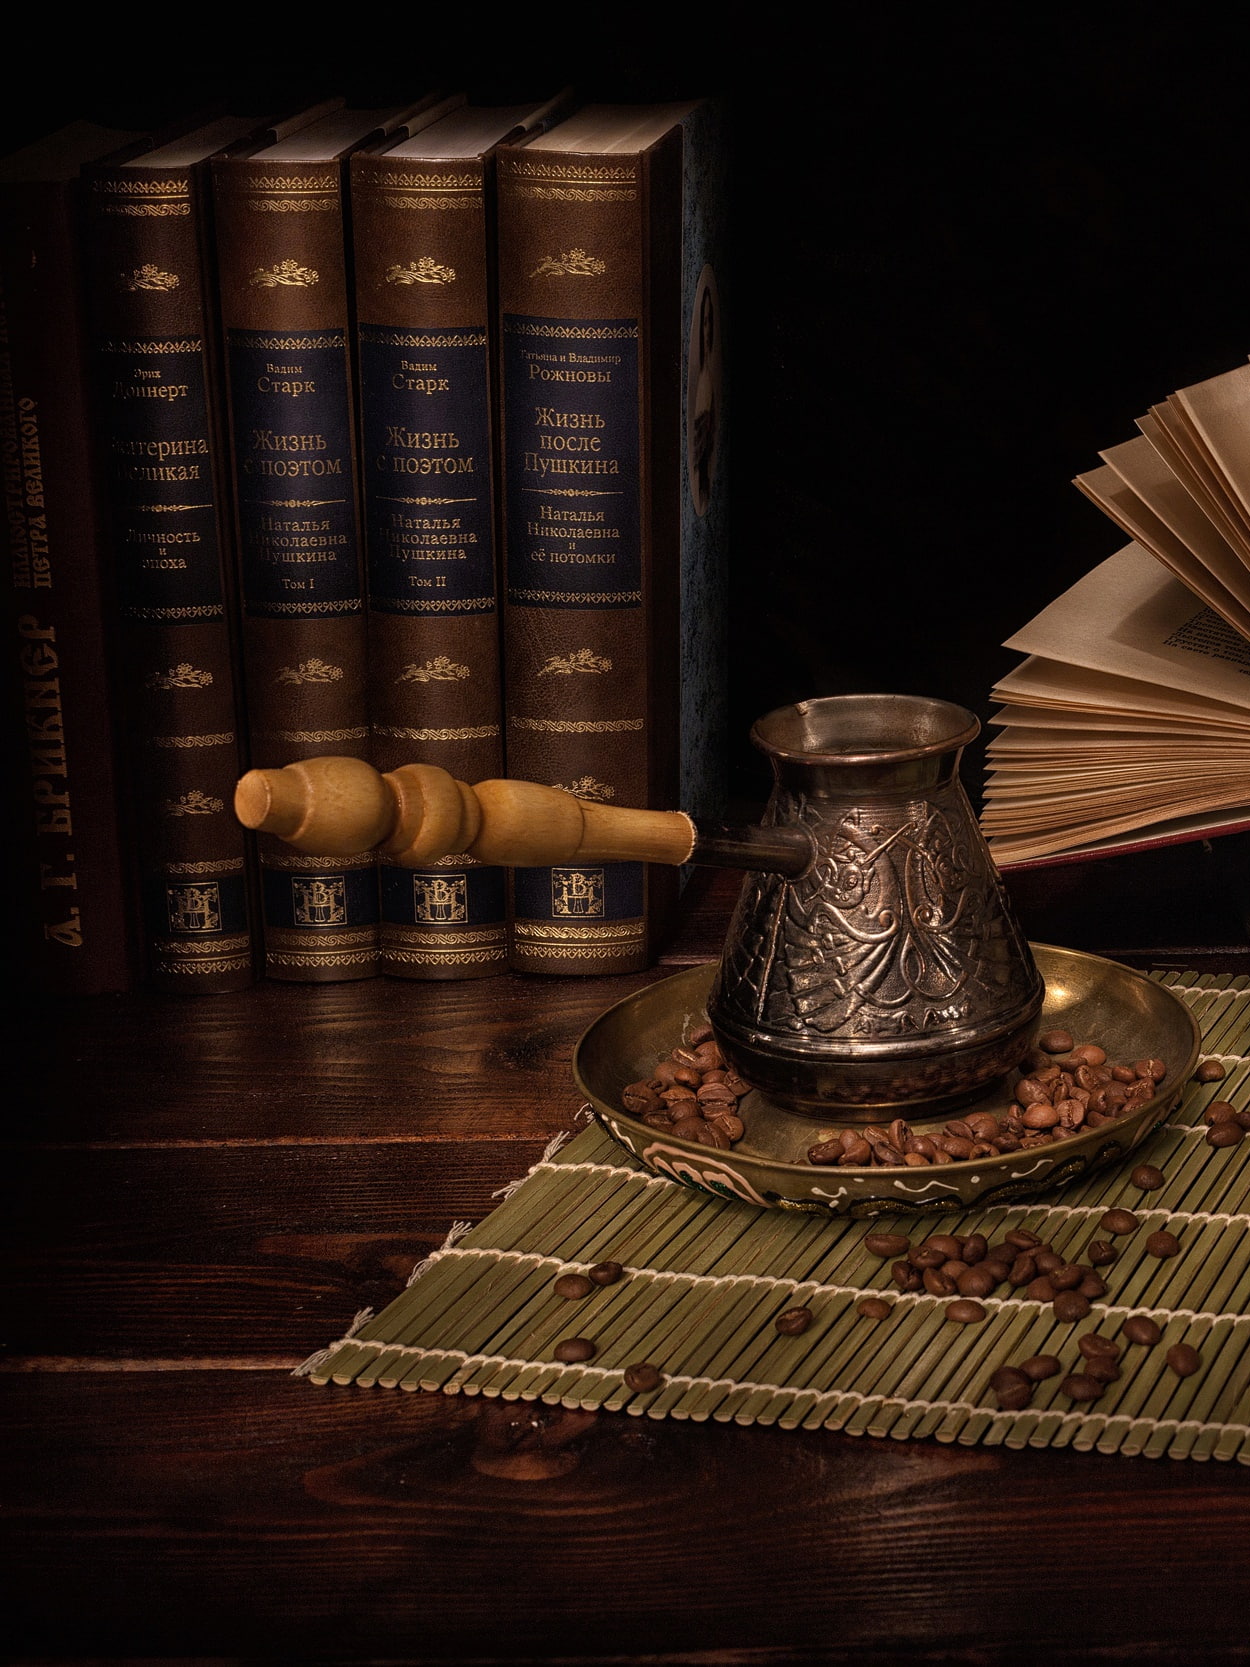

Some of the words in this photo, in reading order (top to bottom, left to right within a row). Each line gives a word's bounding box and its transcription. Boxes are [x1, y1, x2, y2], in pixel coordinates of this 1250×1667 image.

[401, 360, 438, 372] Вадим
[568, 353, 622, 365] Владимир
[266, 363, 303, 374] Вадим
[529, 364, 612, 383] Рожновы
[256, 377, 316, 397] Старк
[391, 374, 450, 394] Старк
[535, 406, 606, 429] Жизнь
[253, 429, 327, 452] Жизнь
[386, 426, 460, 450] Жизнь
[540, 434, 602, 452] после
[18, 397, 45, 508] ВЕЛИКОГО
[260, 458, 342, 477] поэтом
[393, 456, 474, 475] поэтом
[524, 452, 620, 477] Пушкина
[392, 514, 461, 530] Наталья
[540, 505, 606, 522] Наталья
[261, 516, 330, 532] Наталья
[527, 522, 620, 539] Николаевна
[28, 514, 52, 589] ПЕТРА
[390, 545, 467, 562] Пушкина
[530, 550, 546, 562] её
[550, 552, 616, 564] потомки
[281, 578, 306, 589] Том
[408, 576, 432, 587] Том
[17, 613, 73, 838] БРИКНЕР
